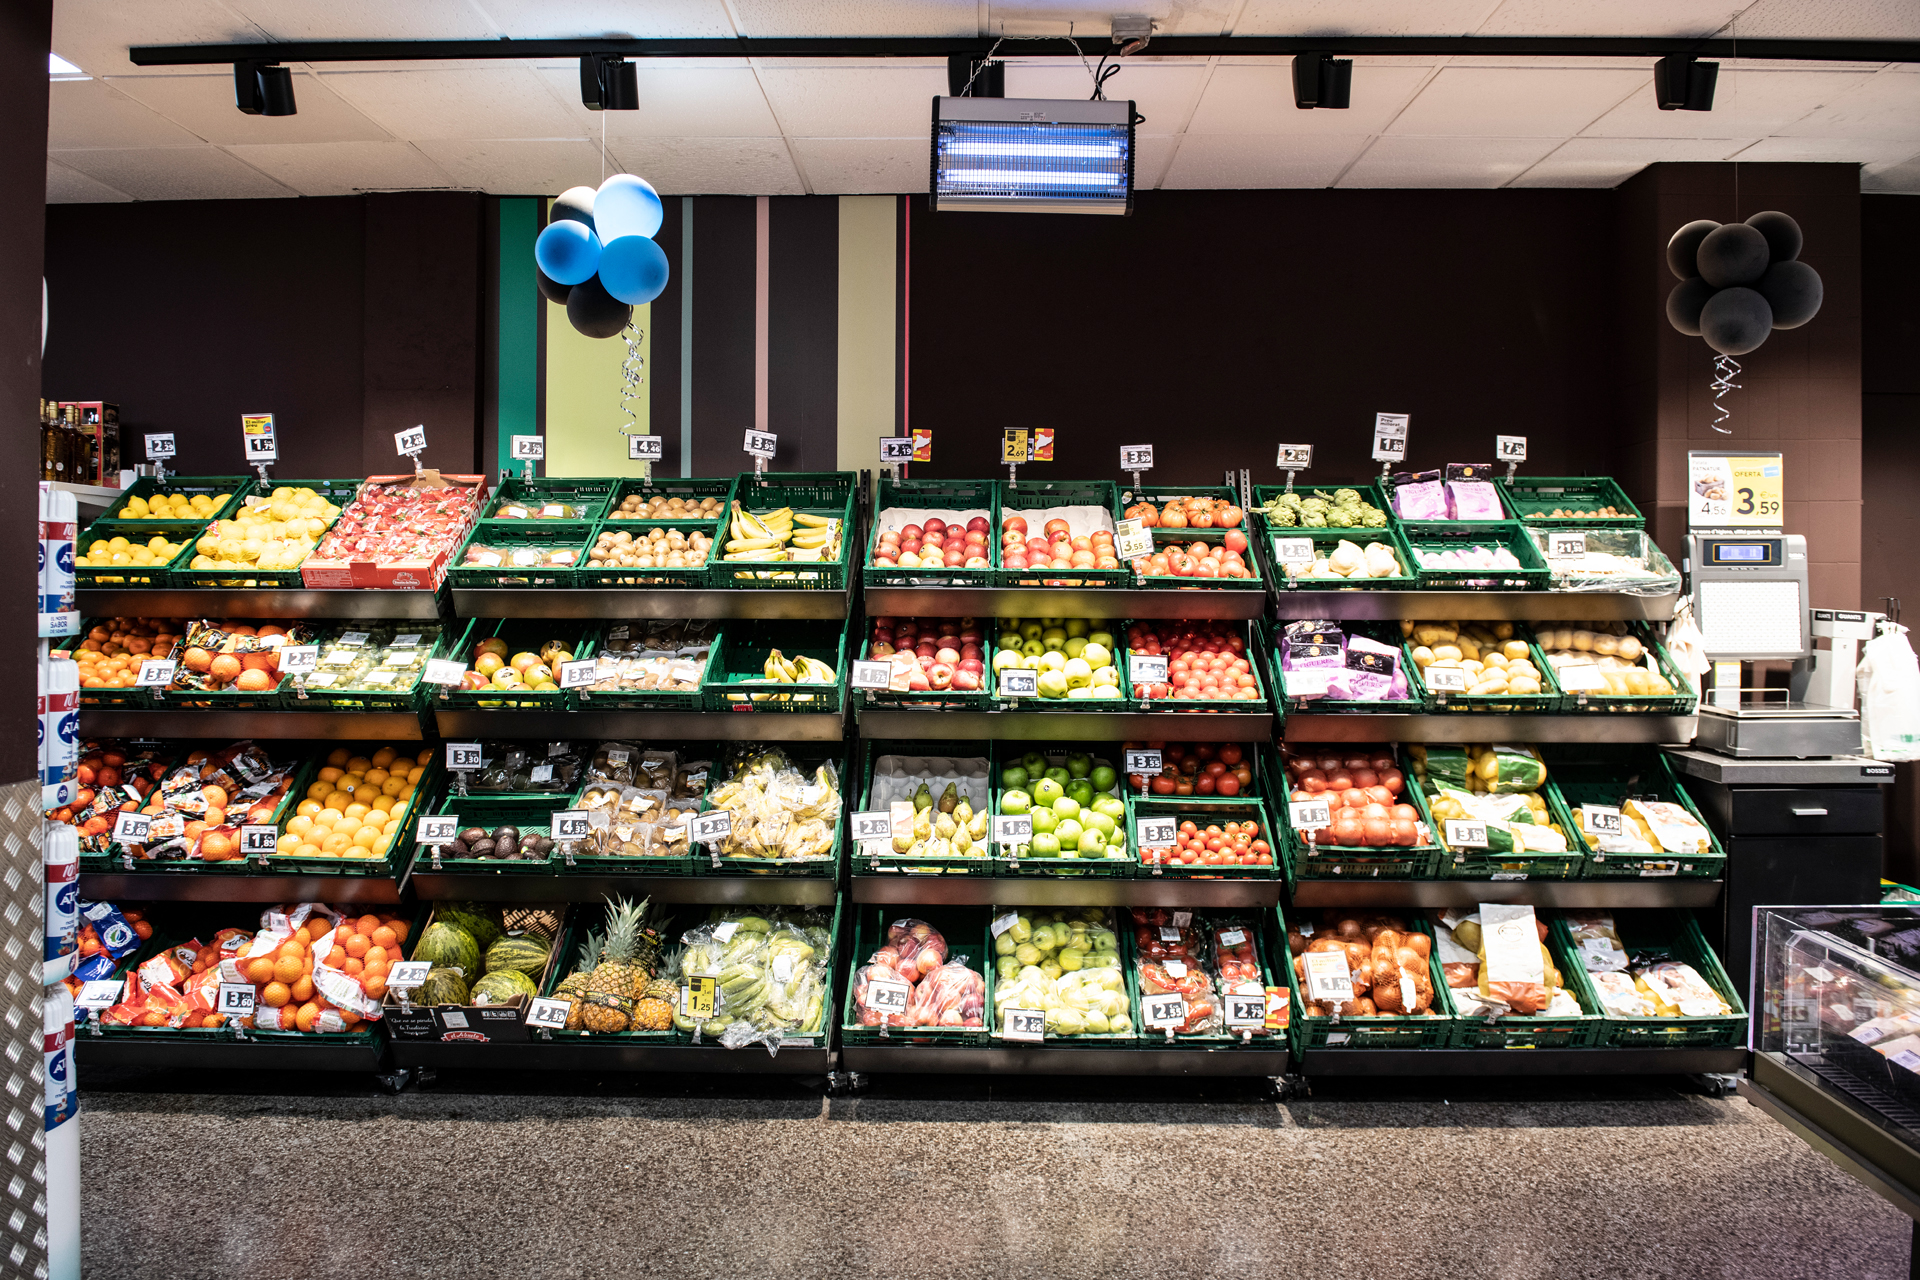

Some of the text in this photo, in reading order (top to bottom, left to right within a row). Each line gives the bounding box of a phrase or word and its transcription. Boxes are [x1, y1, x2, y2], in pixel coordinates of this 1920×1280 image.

[154, 440, 174, 452] 2,29
[254, 440, 274, 451] 1,79
[522, 442, 542, 454] 2,79
[640, 441, 661, 454] 4,46
[755, 437, 774, 450] 3,95
[891, 444, 910, 456] 2,19
[1384, 439, 1403, 451] 1,85
[1008, 445, 1025, 457] 2,69
[1130, 452, 1150, 463] 3,99
[1287, 450, 1308, 462] 2,99
[1702, 502, 1726, 515] 4,56
[1736, 488, 1780, 515] 3,59
[1124, 540, 1144, 552] 3,55
[150, 668, 171, 681] 3,99
[572, 668, 592, 682] 3,40
[864, 669, 887, 683] 1,75
[457, 750, 478, 764] 3,30
[1138, 756, 1160, 768] 3,55
[124, 821, 148, 836] 3,69
[430, 824, 454, 838] 5,59
[562, 820, 586, 834] 4,35
[704, 820, 729, 834] 2,93
[864, 820, 888, 834] 2,02
[1006, 821, 1030, 835] 1,69
[1150, 826, 1174, 842] 3,55
[252, 834, 276, 848] 1,89
[230, 992, 252, 1007] 3,60
[692, 996, 710, 1012] 1,25
[878, 988, 905, 1006] 2,78
[540, 1007, 564, 1022] 2,59
[1156, 1003, 1182, 1019] 2,55
[1238, 1004, 1264, 1018] 2,79
[1016, 1016, 1042, 1032] 2,66
